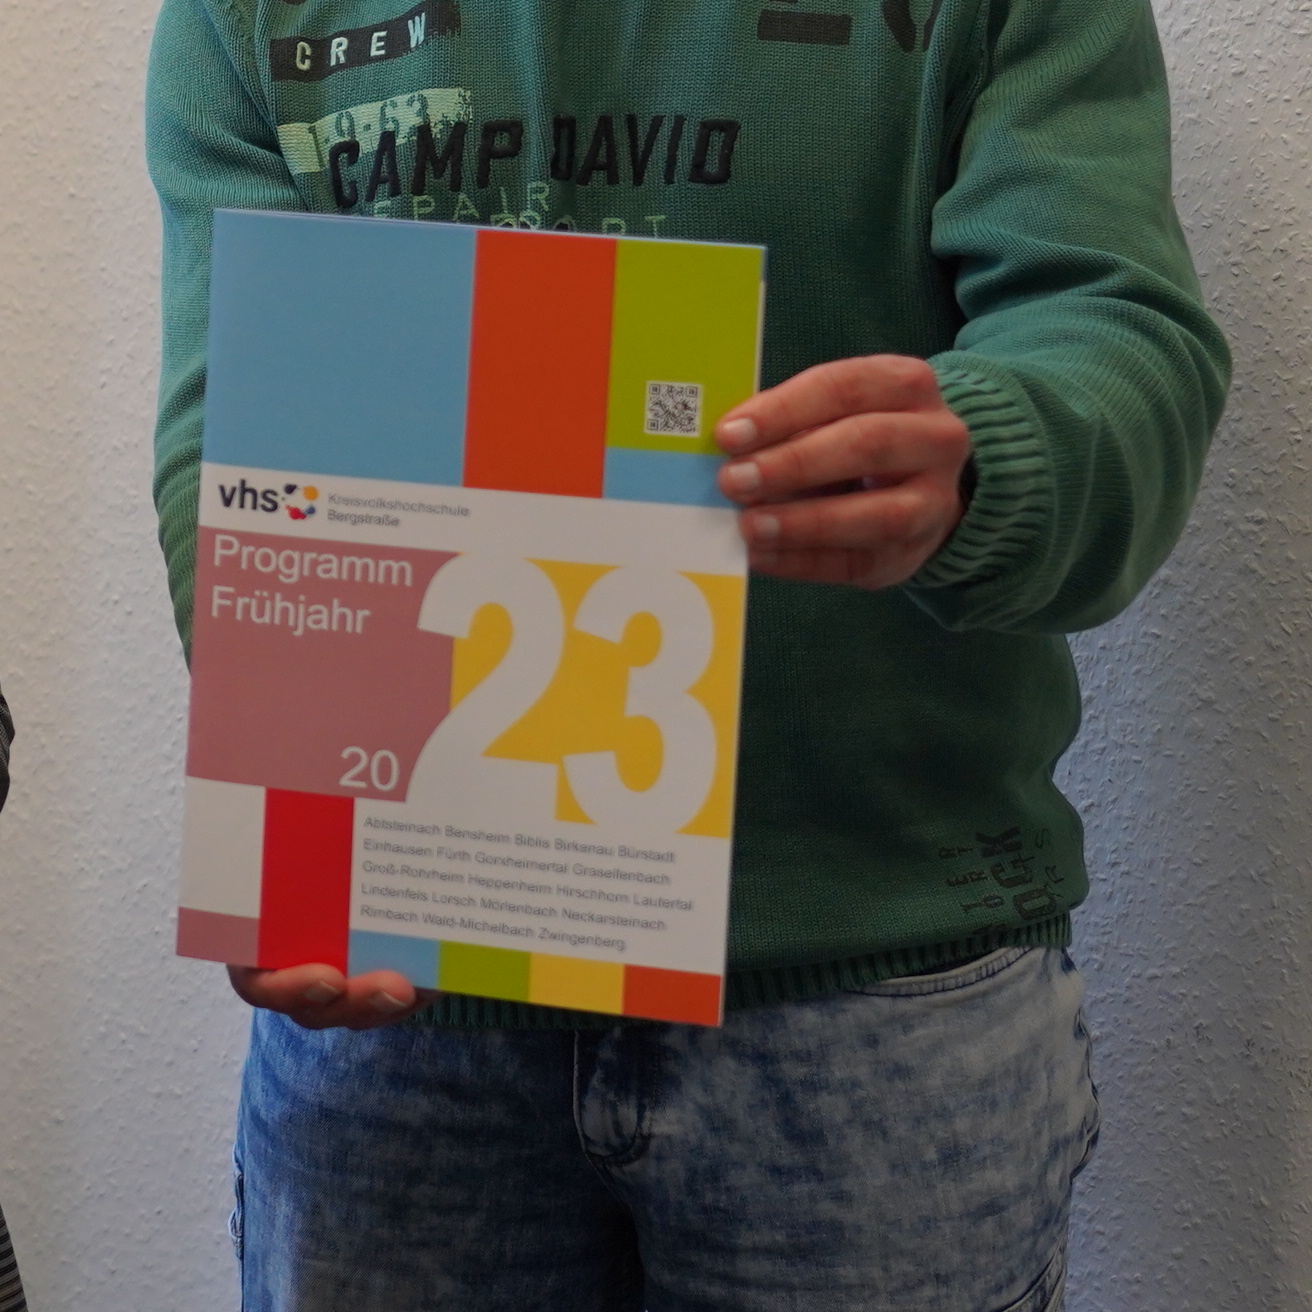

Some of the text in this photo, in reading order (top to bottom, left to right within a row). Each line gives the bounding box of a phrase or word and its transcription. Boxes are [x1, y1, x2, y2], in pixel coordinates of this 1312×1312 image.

[295, 11, 426, 71] CREW
[327, 113, 741, 209] CAMP DAVID
[217, 478, 279, 513] vhs
[327, 508, 401, 527] Bergstraße
[328, 492, 470, 517] Kreisvolkshochschule
[213, 533, 413, 588] Programm
[211, 584, 371, 636] Frühjahr
[338, 552, 717, 828] 20 23
